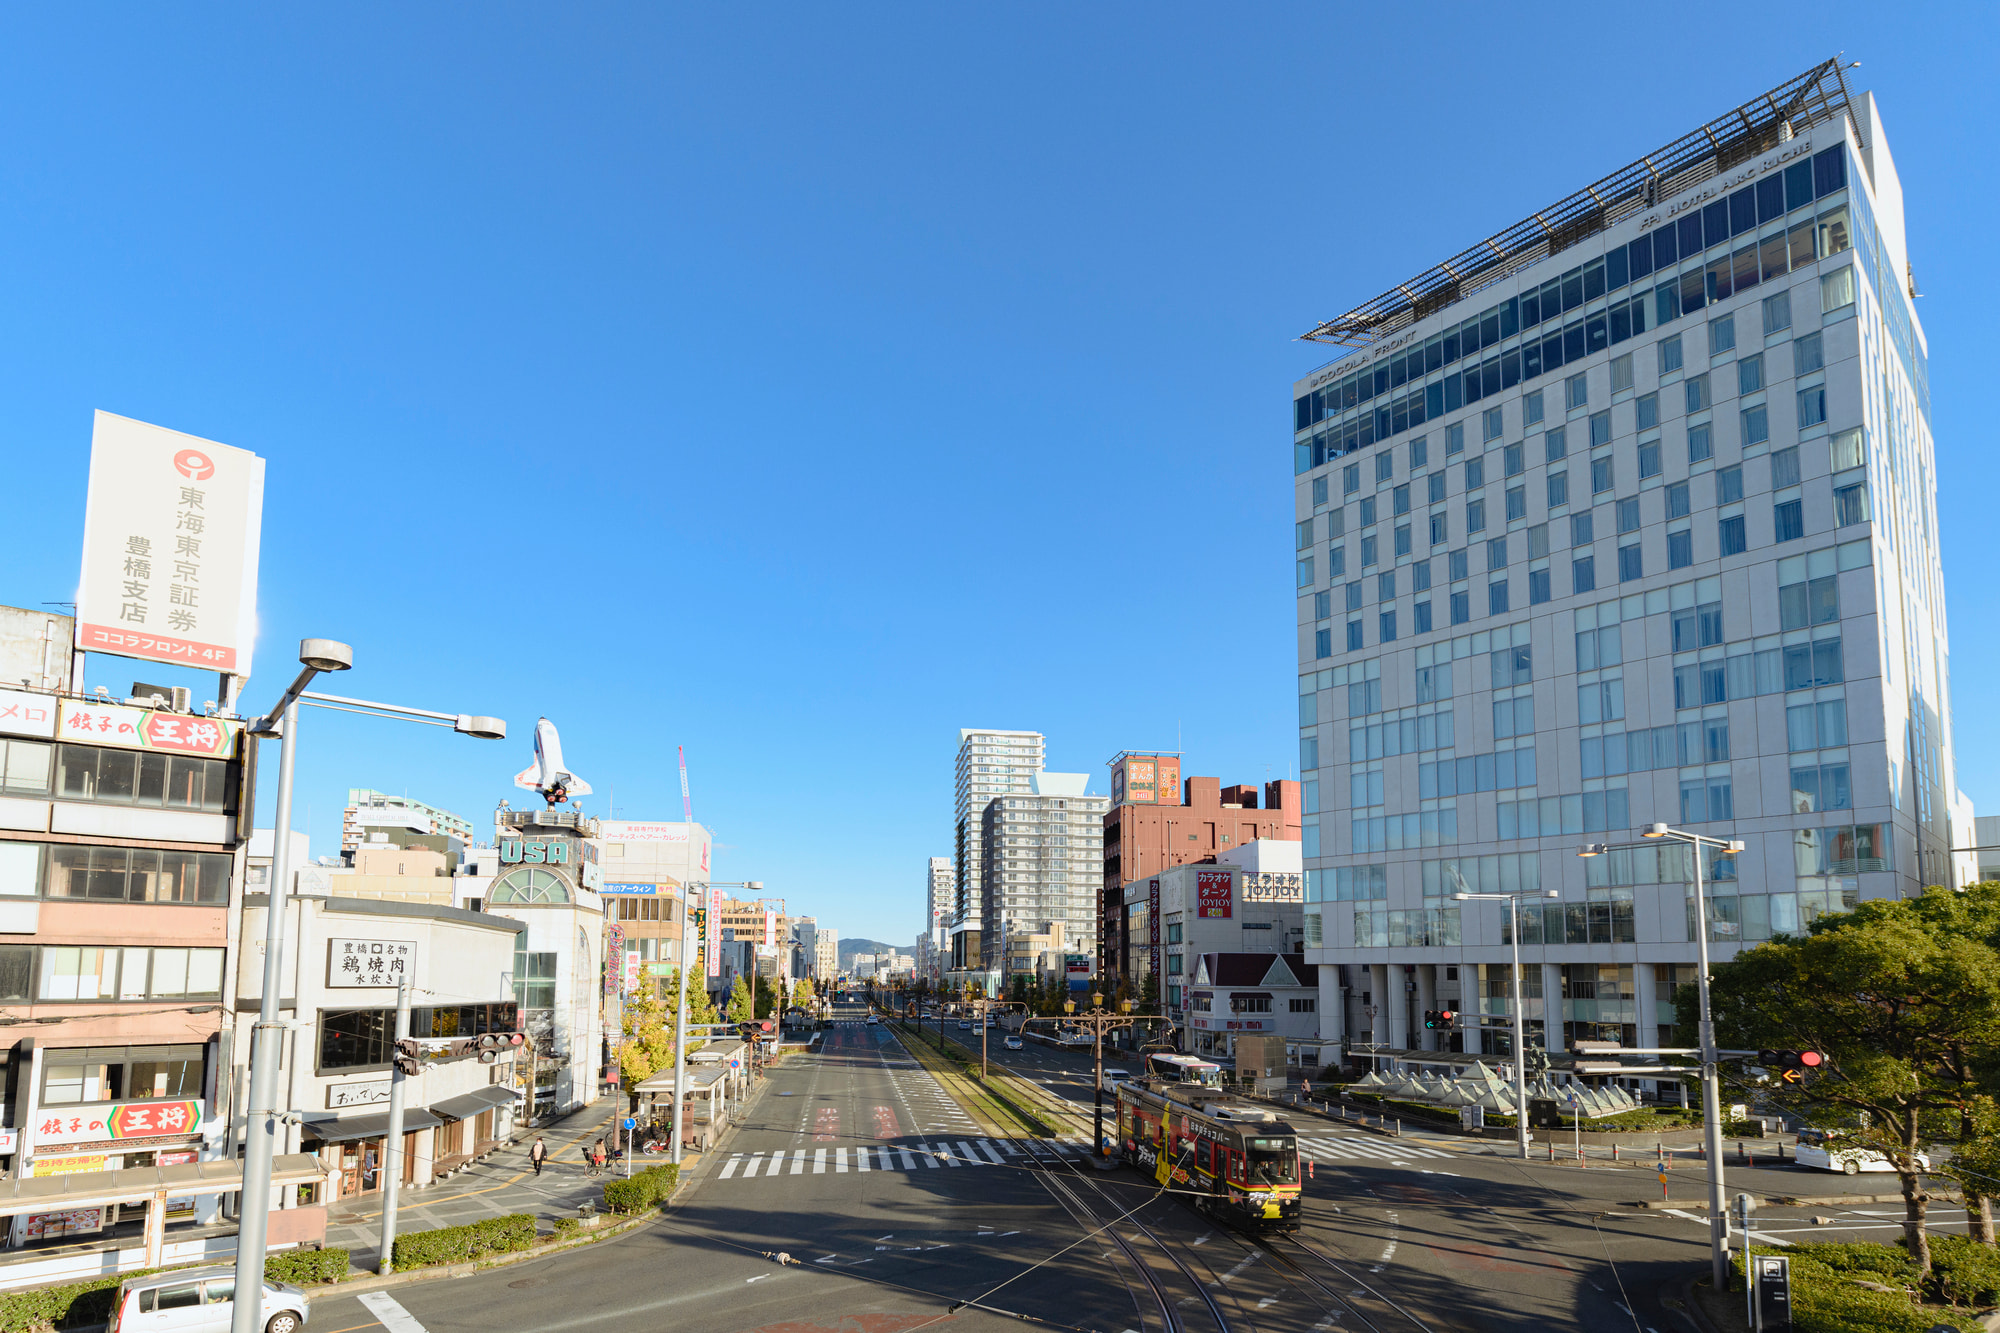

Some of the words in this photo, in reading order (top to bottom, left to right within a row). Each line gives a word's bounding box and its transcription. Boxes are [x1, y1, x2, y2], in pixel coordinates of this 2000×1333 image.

[1668, 186, 1716, 217] HOTEL
[1721, 168, 1756, 193] ARC
[1760, 142, 1811, 173] RICHE
[1318, 354, 1370, 384] COCOLA
[1374, 330, 1417, 358] FRONT
[168, 486, 206, 632] 東海東京証券
[120, 535, 152, 624] 豊橋支店
[94, 630, 198, 656] ココラフロント
[203, 648, 226, 661] 4F
[1130, 764, 1154, 772] ネット
[501, 841, 569, 864] USA
[1198, 873, 1231, 883] カラオケ
[1248, 873, 1299, 886] カラオケ
[1151, 882, 1159, 911] カラオケ
[1202, 888, 1228, 897] ダーツ
[343, 942, 368, 954] 豊橋
[385, 944, 408, 955] 名物
[1151, 945, 1159, 975] カラオケ
[342, 955, 404, 974] 鶏焼肉
[355, 973, 393, 985] 水炊き
[39, 1106, 186, 1135] 餃子の王将
[37, 1155, 102, 1168] お持ち帰り
